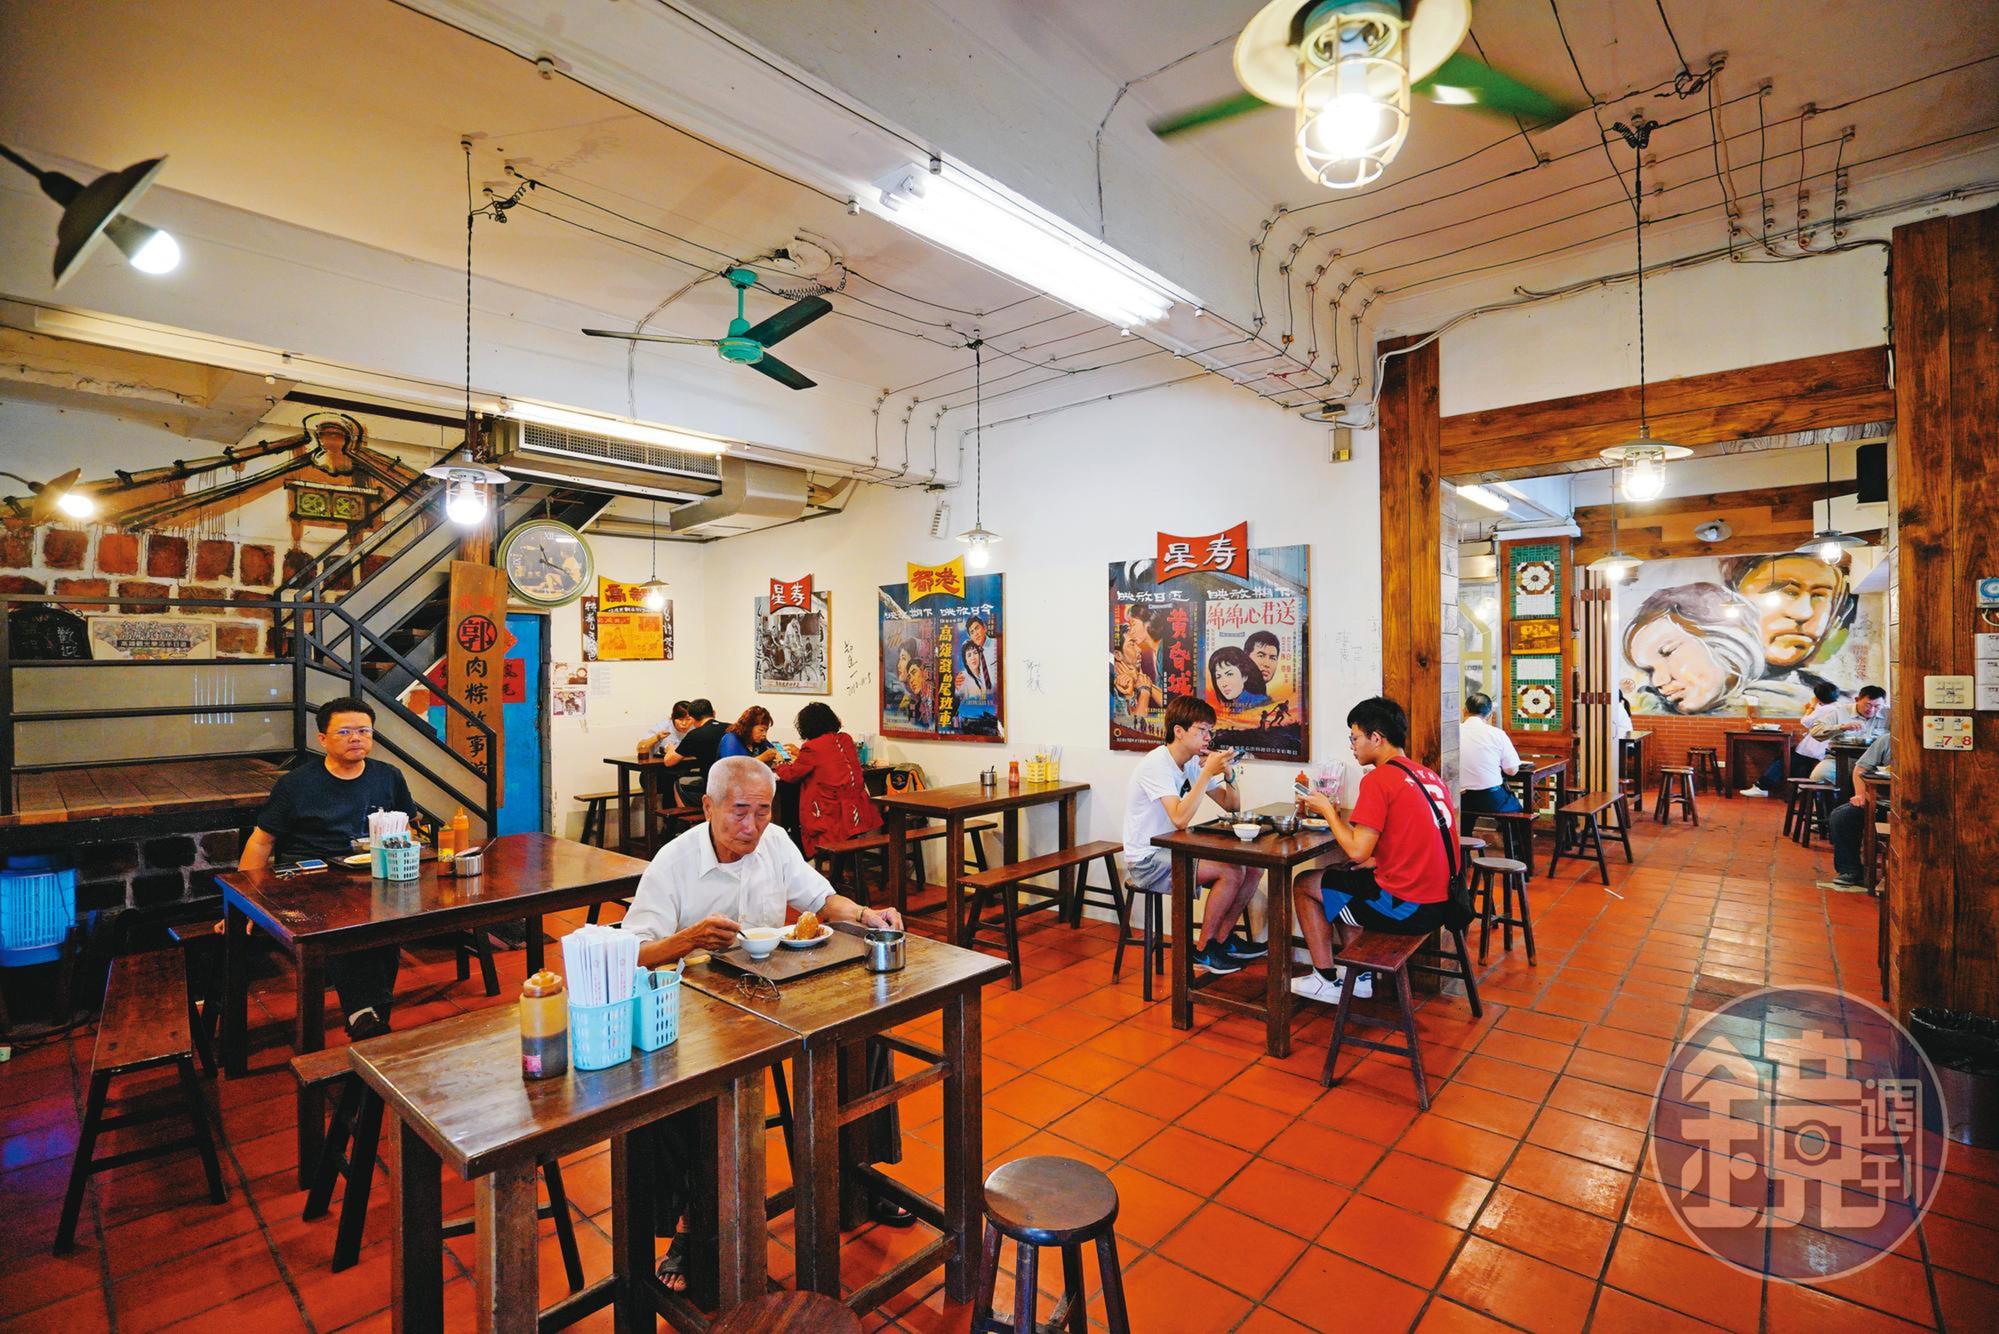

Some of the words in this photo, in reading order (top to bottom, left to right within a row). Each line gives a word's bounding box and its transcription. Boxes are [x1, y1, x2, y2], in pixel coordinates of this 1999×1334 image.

[457, 615, 498, 653] 郭
[1943, 735, 1953, 746] 7
[1961, 735, 1972, 746] 8
